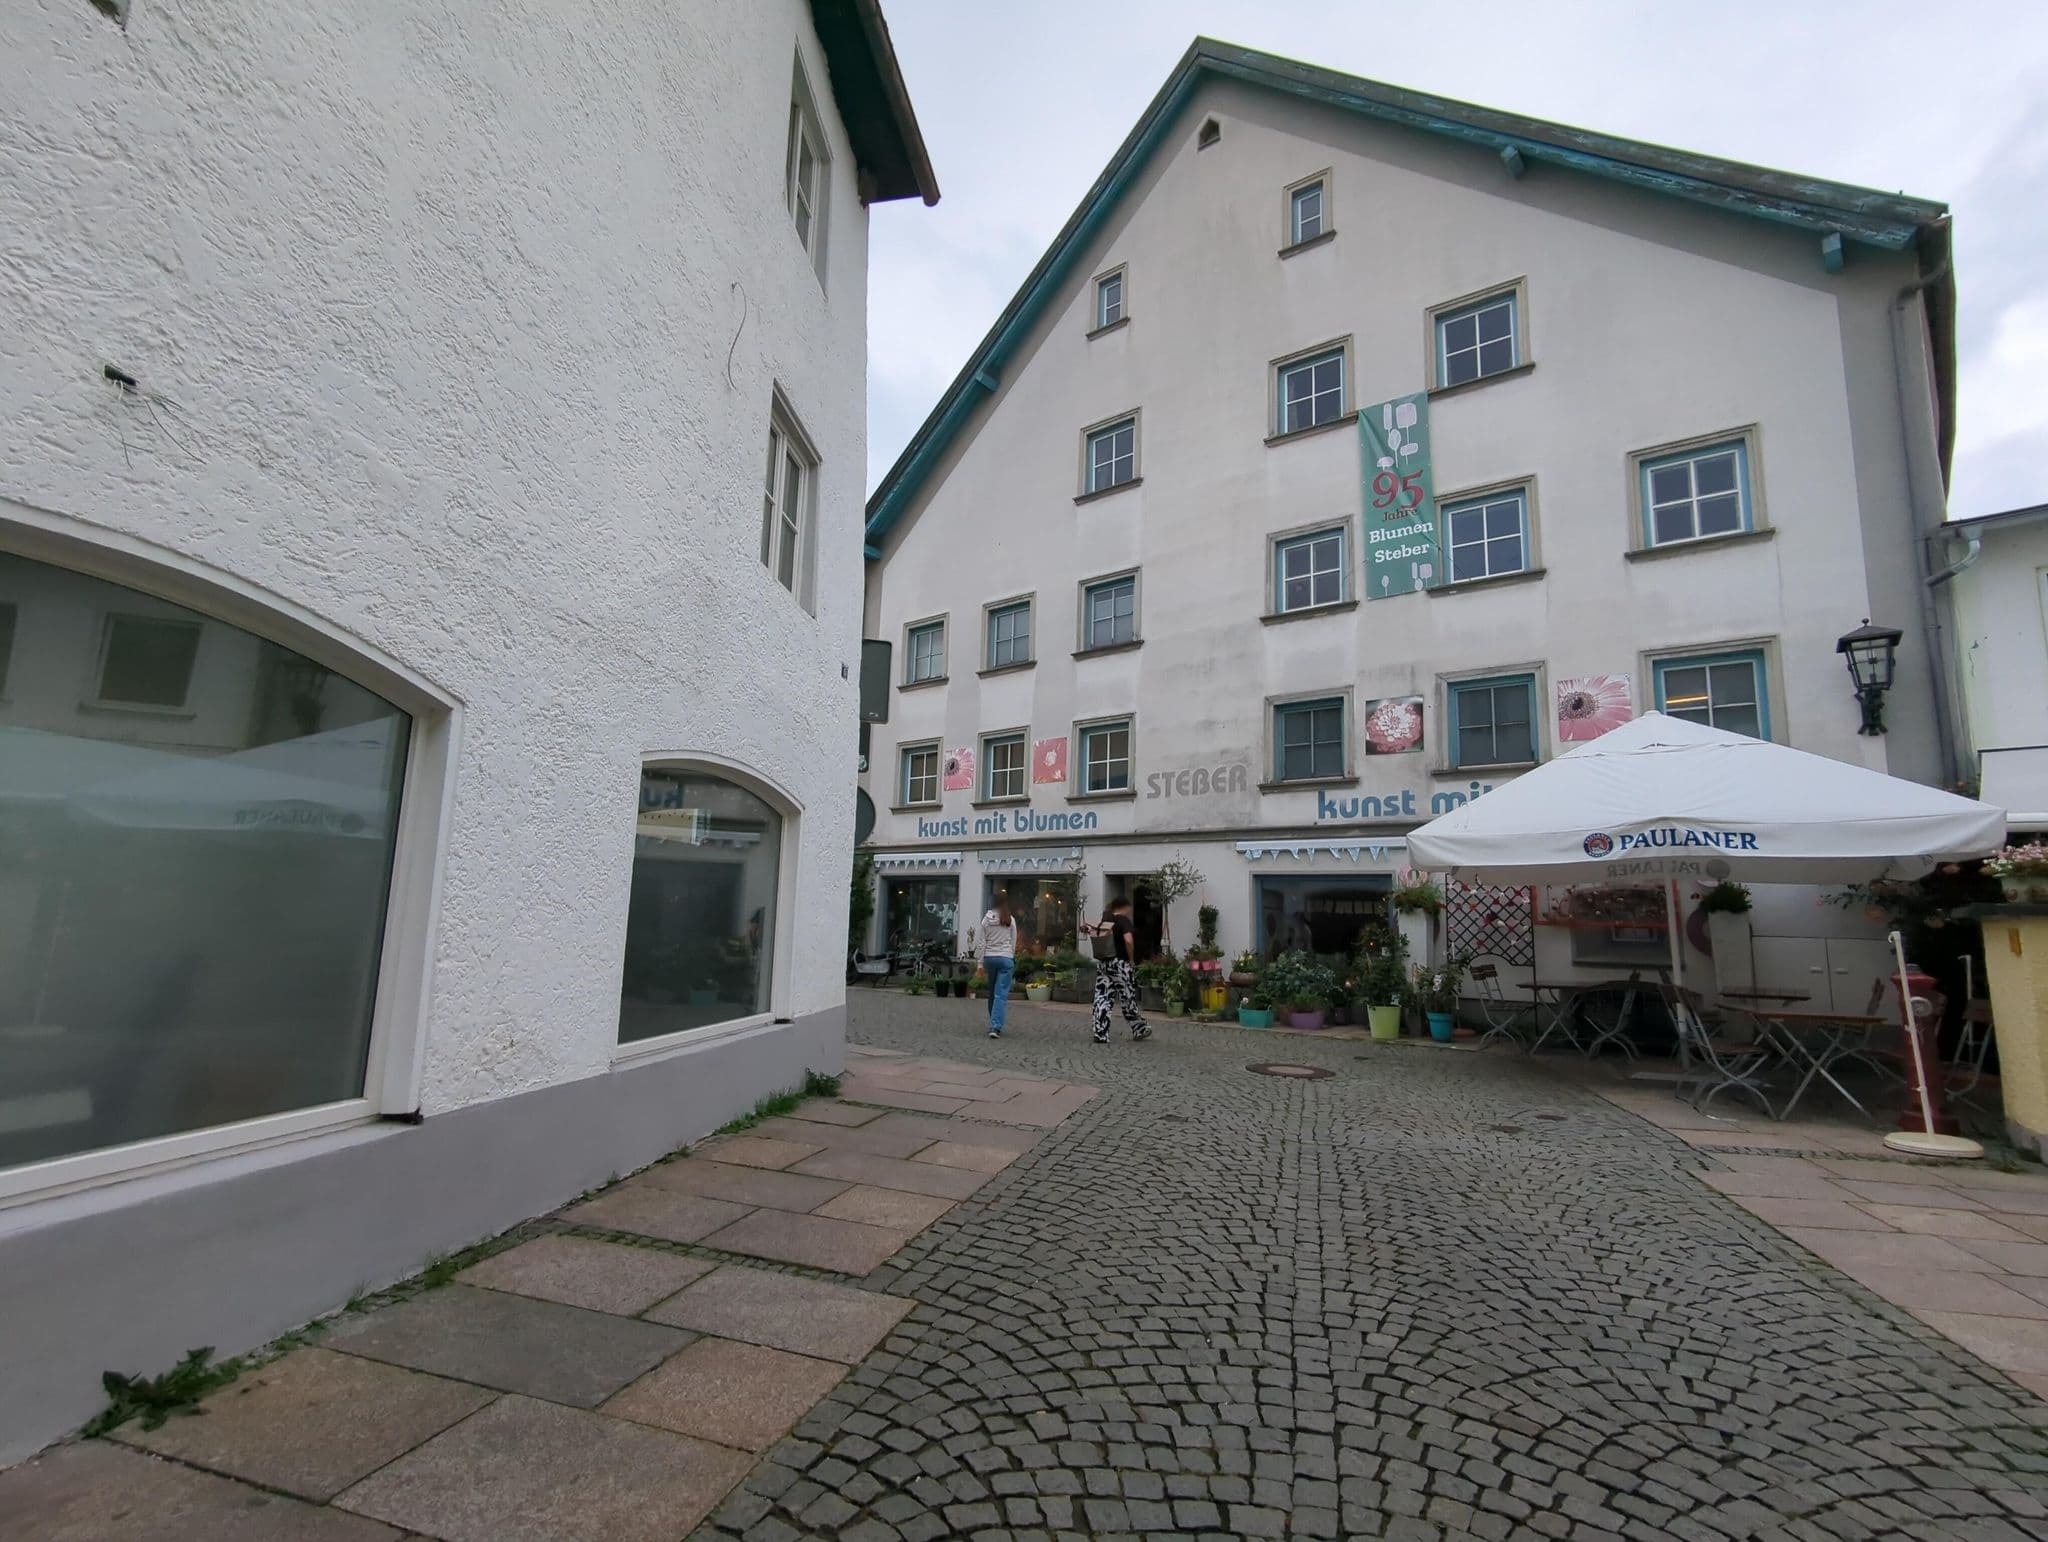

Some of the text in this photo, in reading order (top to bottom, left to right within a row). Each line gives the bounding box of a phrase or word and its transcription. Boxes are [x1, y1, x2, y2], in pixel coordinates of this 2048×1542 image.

[1372, 470, 1424, 509] 95
[1382, 508, 1417, 522] Jahre
[1369, 522, 1434, 544] Blumen
[1374, 543, 1430, 563] Steber
[1317, 781, 1493, 819] kunst mi
[918, 808, 1098, 838] kunst mit blumen
[1619, 828, 1760, 850] PAULANER
